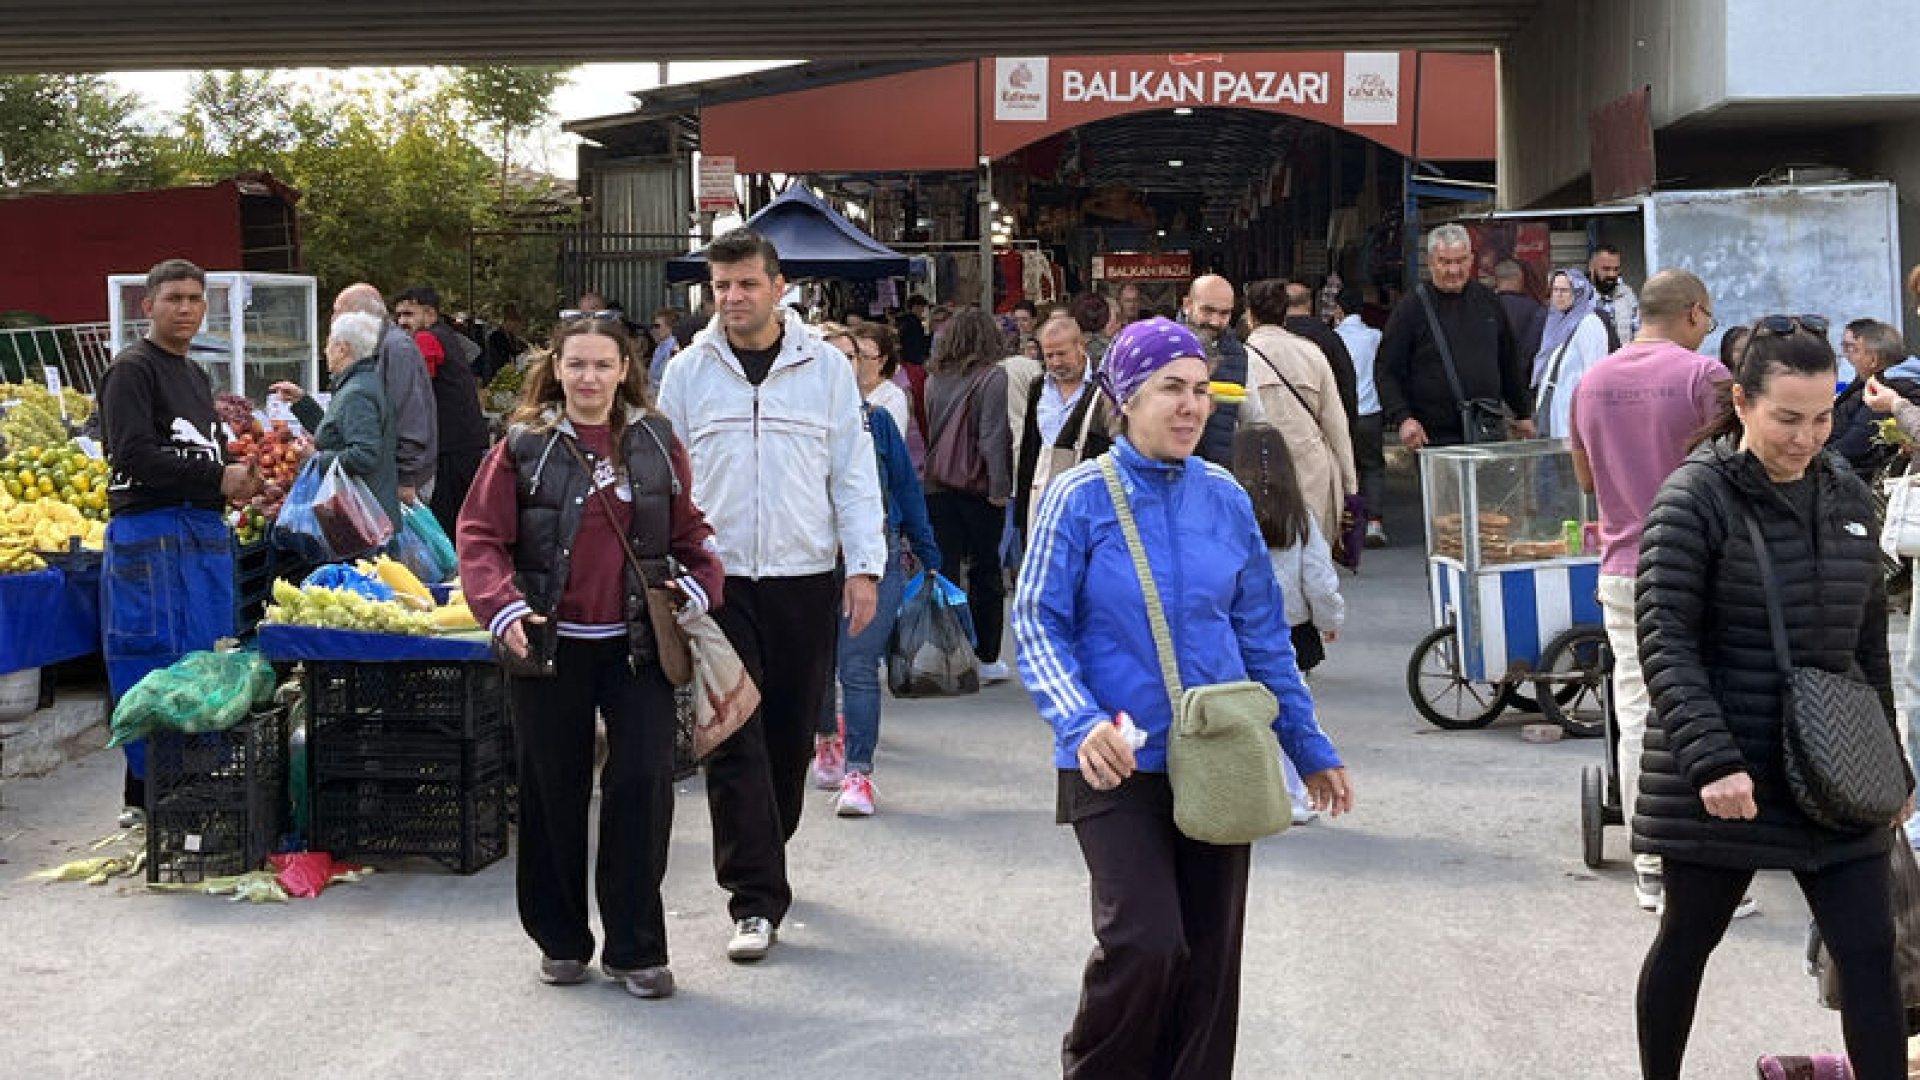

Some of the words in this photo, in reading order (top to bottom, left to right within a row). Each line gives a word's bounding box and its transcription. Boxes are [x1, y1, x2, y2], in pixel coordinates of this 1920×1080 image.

[1062, 71, 1205, 102] BALKAN
[1213, 71, 1329, 103] PAZARI
[1107, 265, 1155, 277] BALKAN
[1158, 264, 1191, 277] PAZA
